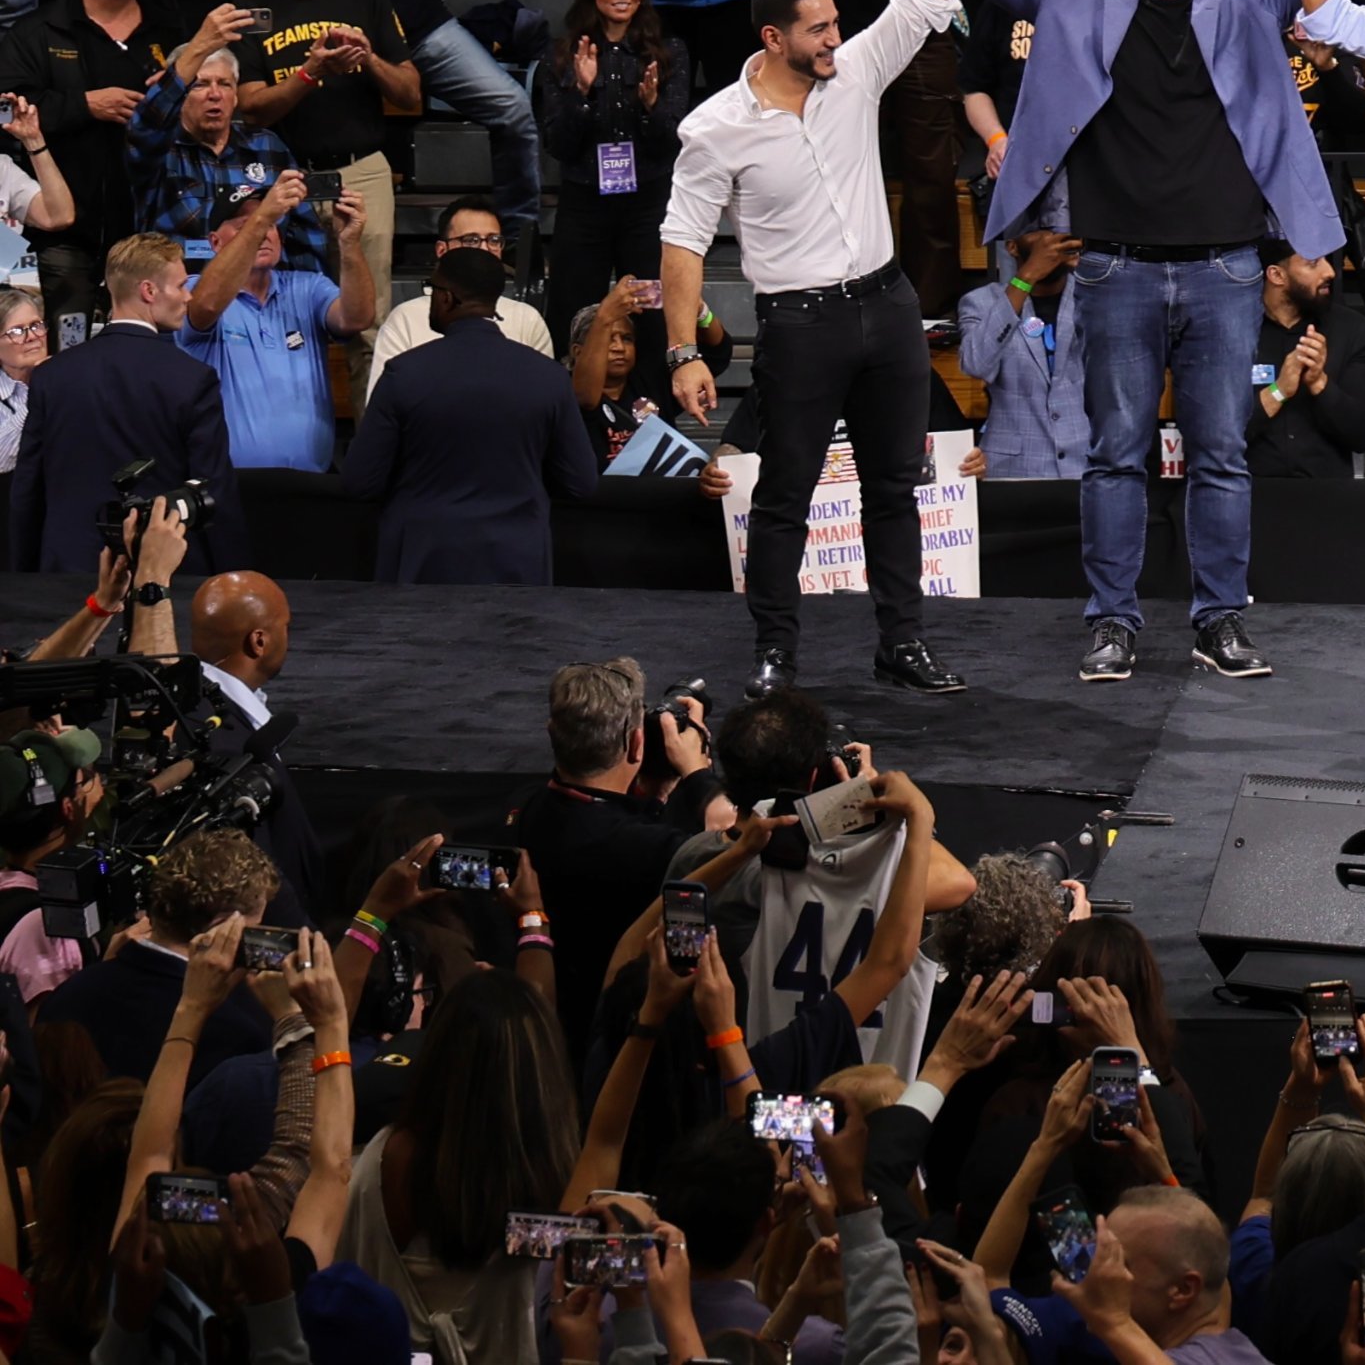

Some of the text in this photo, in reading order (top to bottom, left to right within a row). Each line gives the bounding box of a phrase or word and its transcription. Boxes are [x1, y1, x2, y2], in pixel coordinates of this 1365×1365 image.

[602, 158, 631, 170] STAFF
[941, 484, 967, 504] MY
[821, 569, 856, 591] VET.
